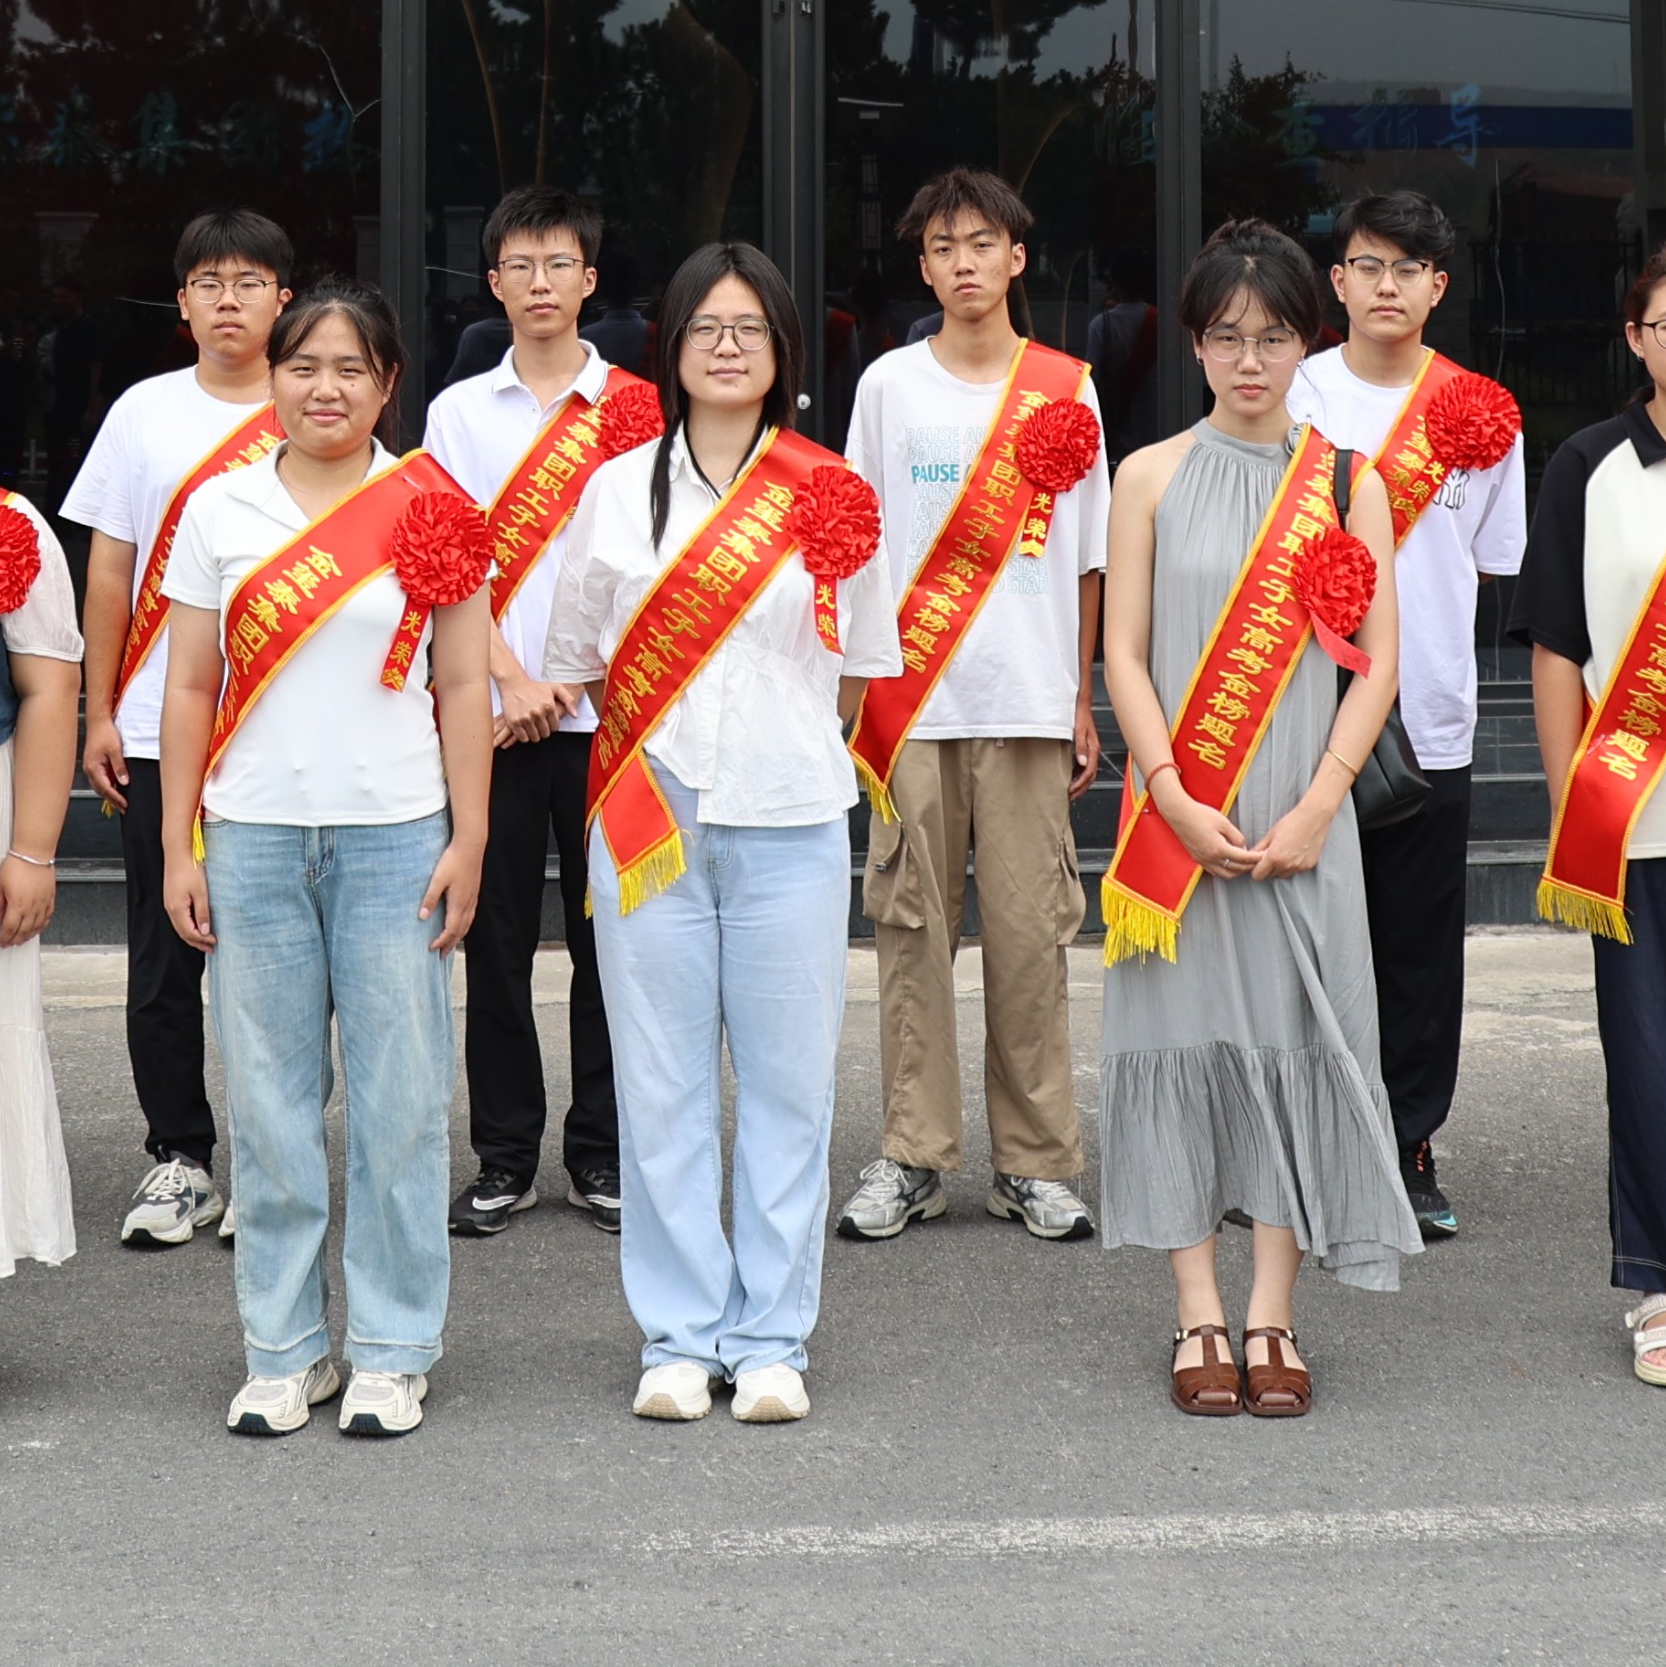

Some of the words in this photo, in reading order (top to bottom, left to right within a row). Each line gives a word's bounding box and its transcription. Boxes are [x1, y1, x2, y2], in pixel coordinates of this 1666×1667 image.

[906, 428, 960, 446] PAUSE
[908, 446, 960, 464] PAUSE
[911, 464, 960, 483] PAUSE
[1407, 460, 1446, 503] 光荣
[1024, 492, 1053, 540] 光荣
[816, 584, 837, 639] 光荣
[390, 611, 421, 668] 光荣
